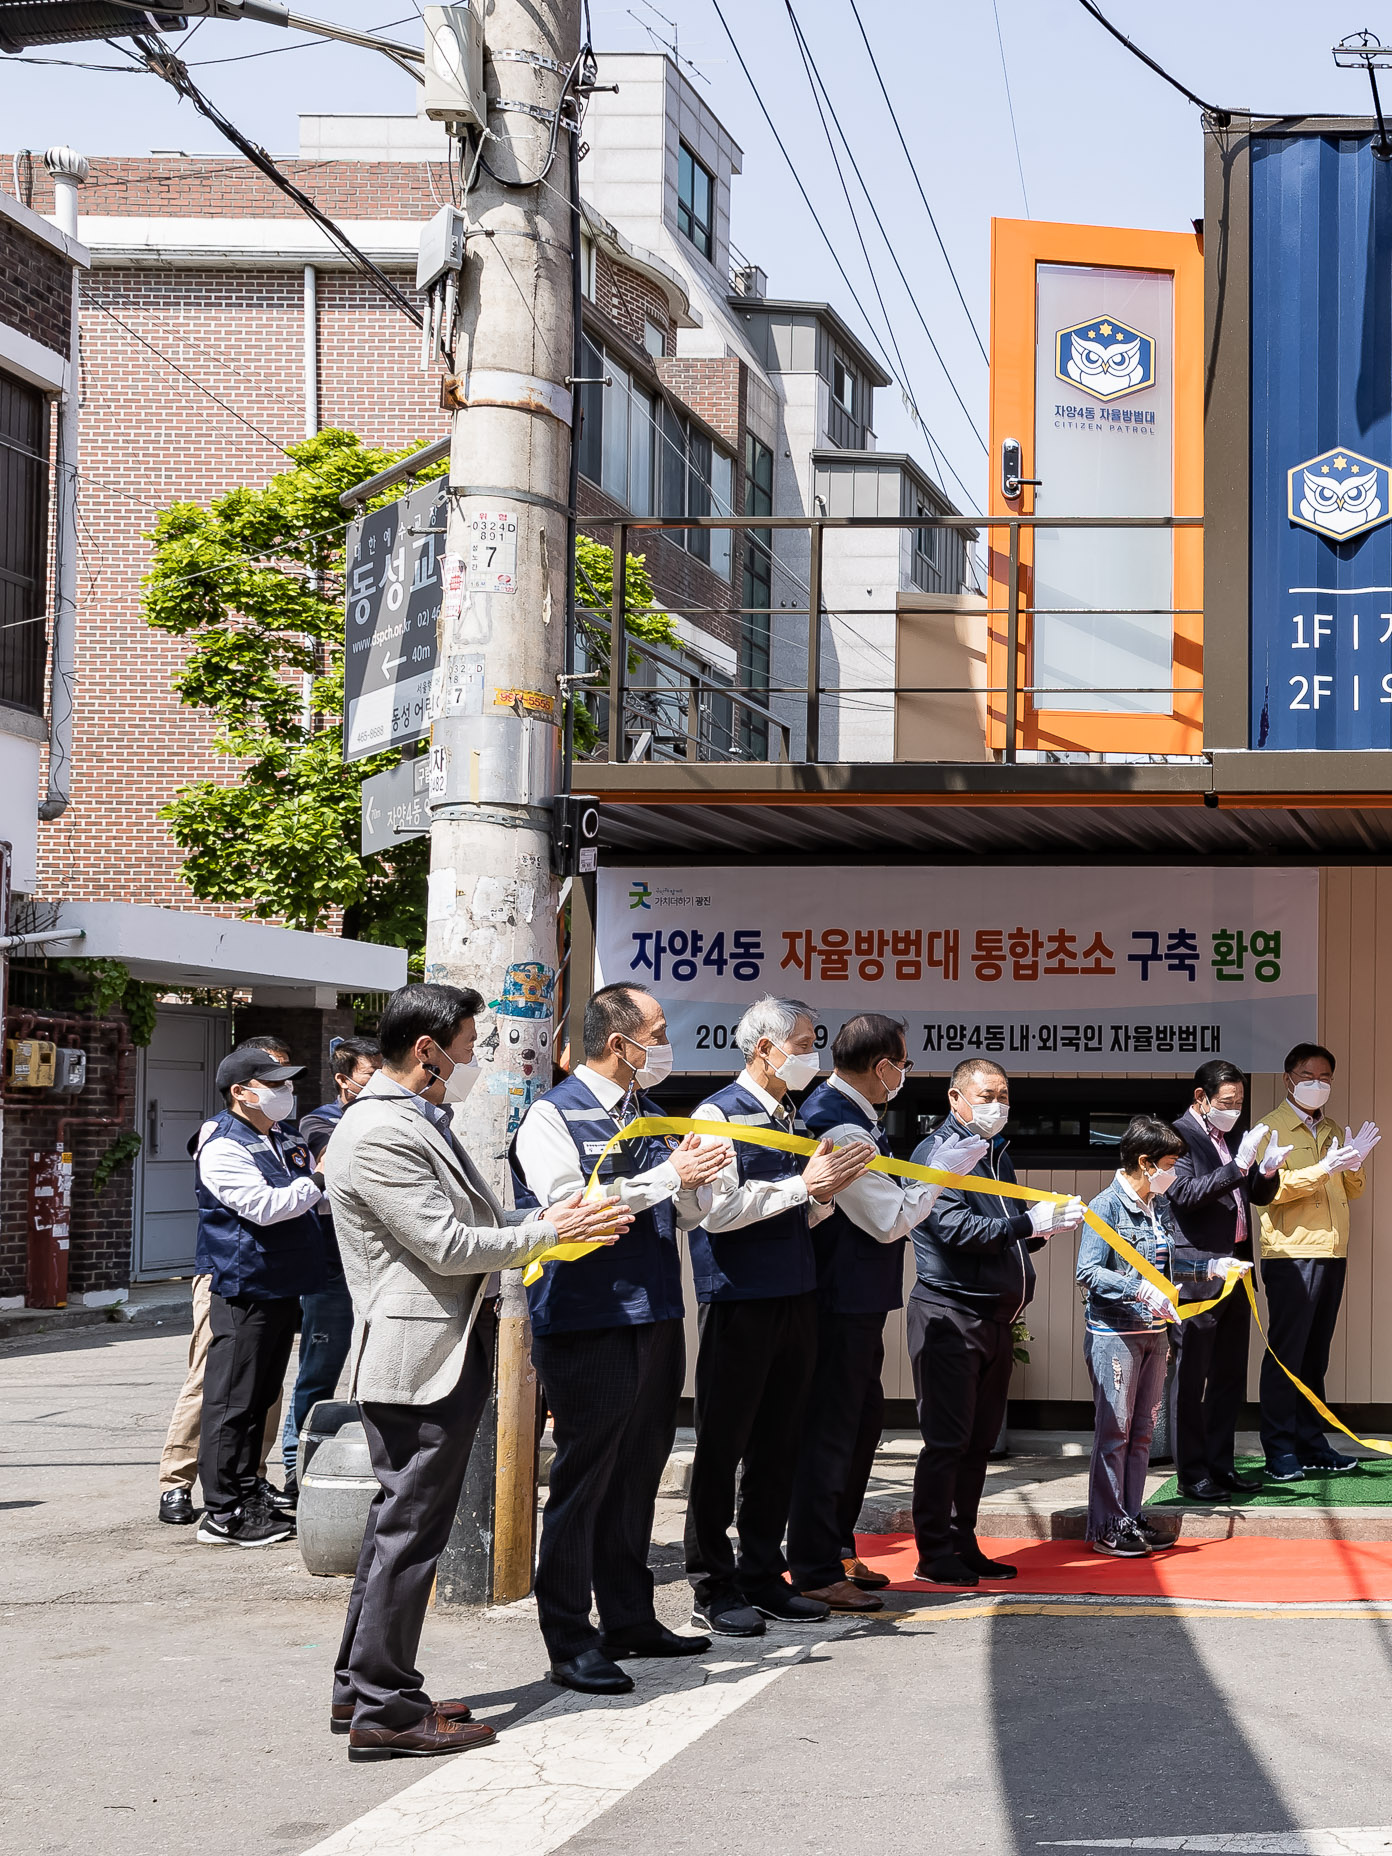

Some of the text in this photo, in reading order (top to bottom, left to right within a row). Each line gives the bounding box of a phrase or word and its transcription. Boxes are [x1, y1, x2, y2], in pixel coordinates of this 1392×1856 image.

[1054, 405, 1155, 425] 자양4동 자율방범대
[1054, 420, 1155, 435] CITIZEN PATROL
[472, 521, 516, 533] 0324D
[480, 531, 504, 542] 891
[486, 546, 497, 568] 7
[1291, 614, 1334, 649] 1F
[412, 645, 430, 663] 40m
[1288, 674, 1334, 711] 2F
[391, 702, 411, 732] 동성
[654, 895, 711, 907] 가치더하기 광진
[629, 926, 1282, 983] 자양4동 자율방범대 통합초소 구축 환영
[1109, 1024, 1222, 1053] 자율방범대
